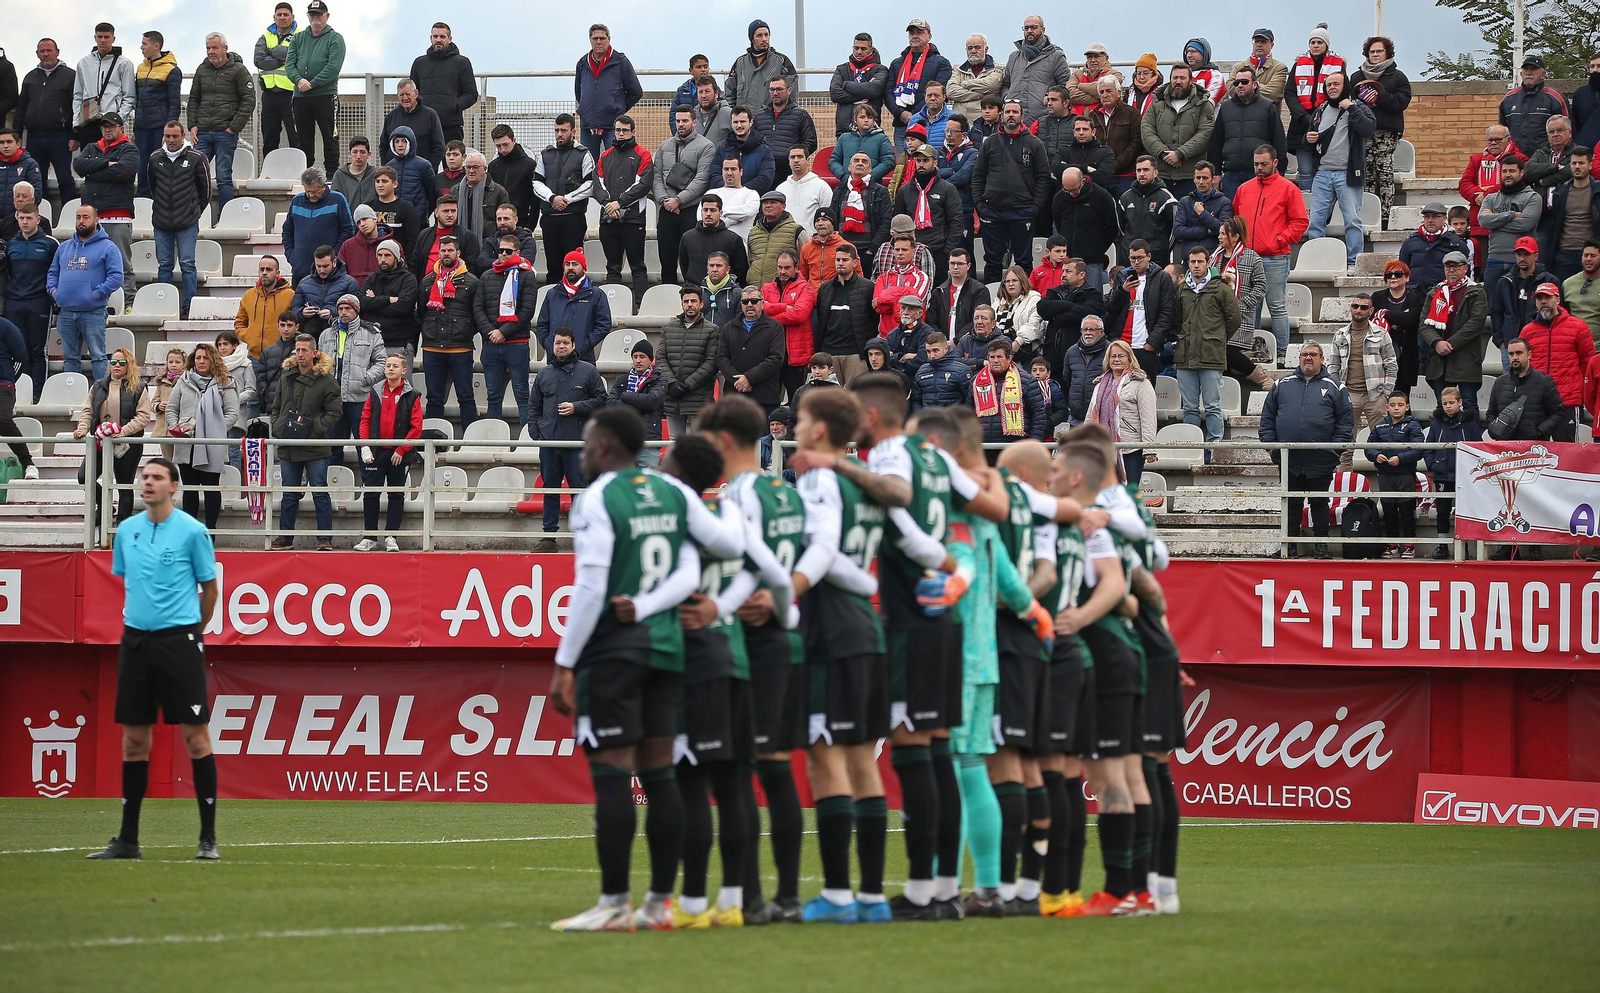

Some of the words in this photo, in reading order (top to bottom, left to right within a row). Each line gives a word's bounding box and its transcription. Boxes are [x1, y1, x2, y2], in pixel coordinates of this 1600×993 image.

[208, 694, 425, 756] ELEAL
[450, 693, 576, 756] S.L.
[1168, 688, 1394, 771] lencia
[286, 770, 489, 793] WWW.ELEAL.ES
[1182, 781, 1352, 809] CABALLEROS
[1453, 800, 1600, 829] GIVOVA
